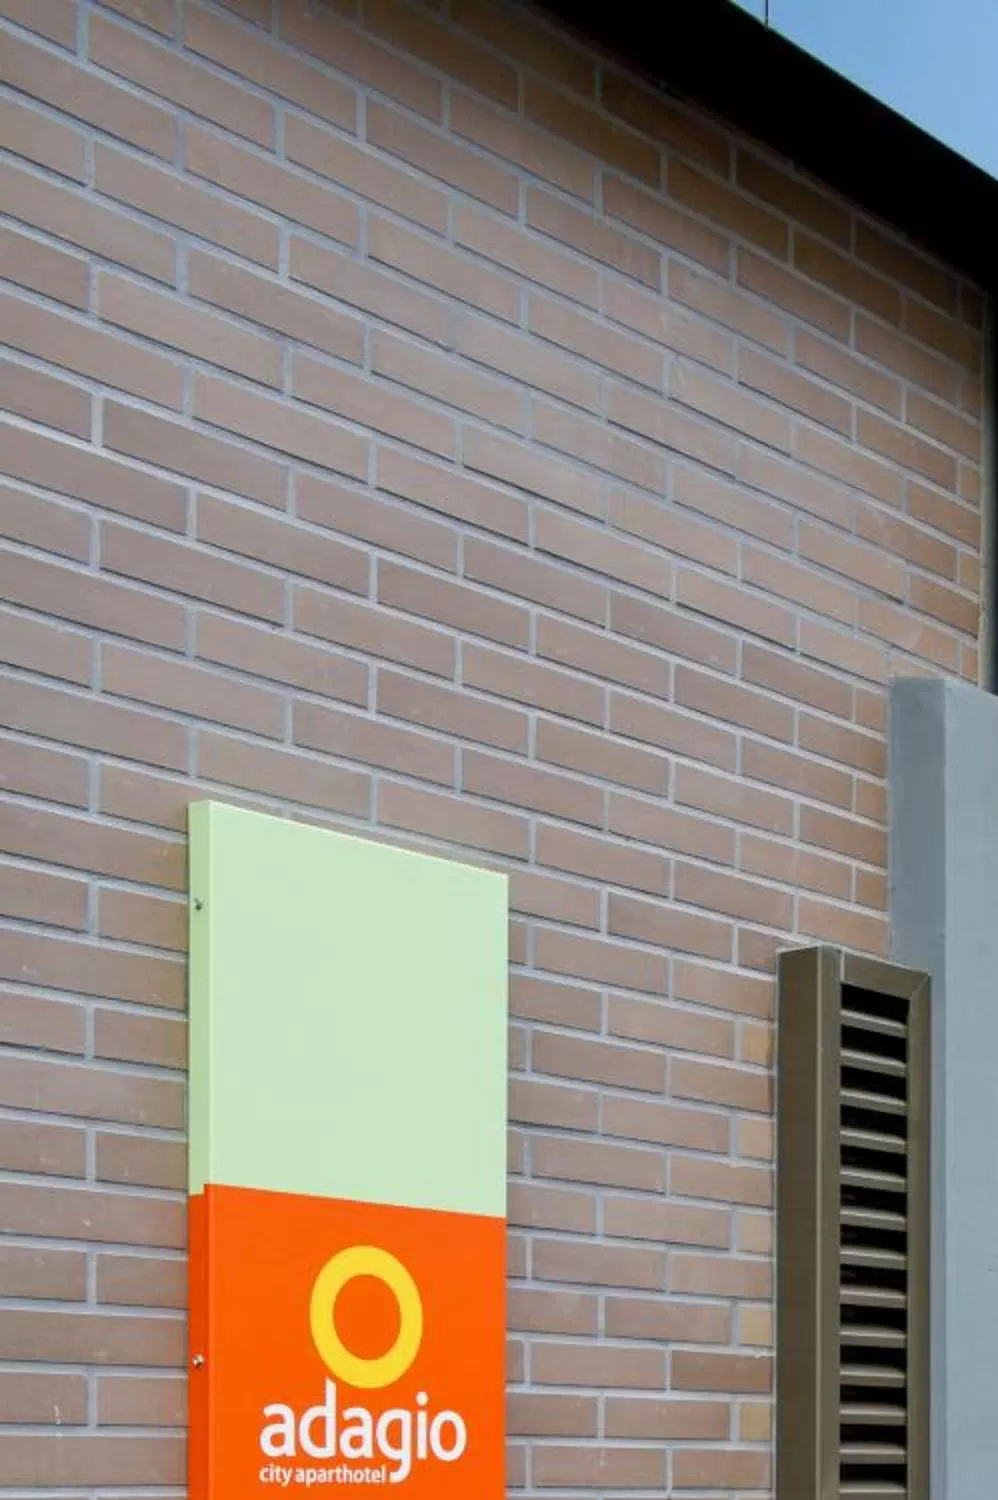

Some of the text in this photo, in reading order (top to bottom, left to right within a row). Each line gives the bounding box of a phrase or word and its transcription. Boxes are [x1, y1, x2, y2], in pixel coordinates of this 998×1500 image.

[259, 1375, 467, 1484] adagio
[258, 1463, 387, 1488] city aparthotel
